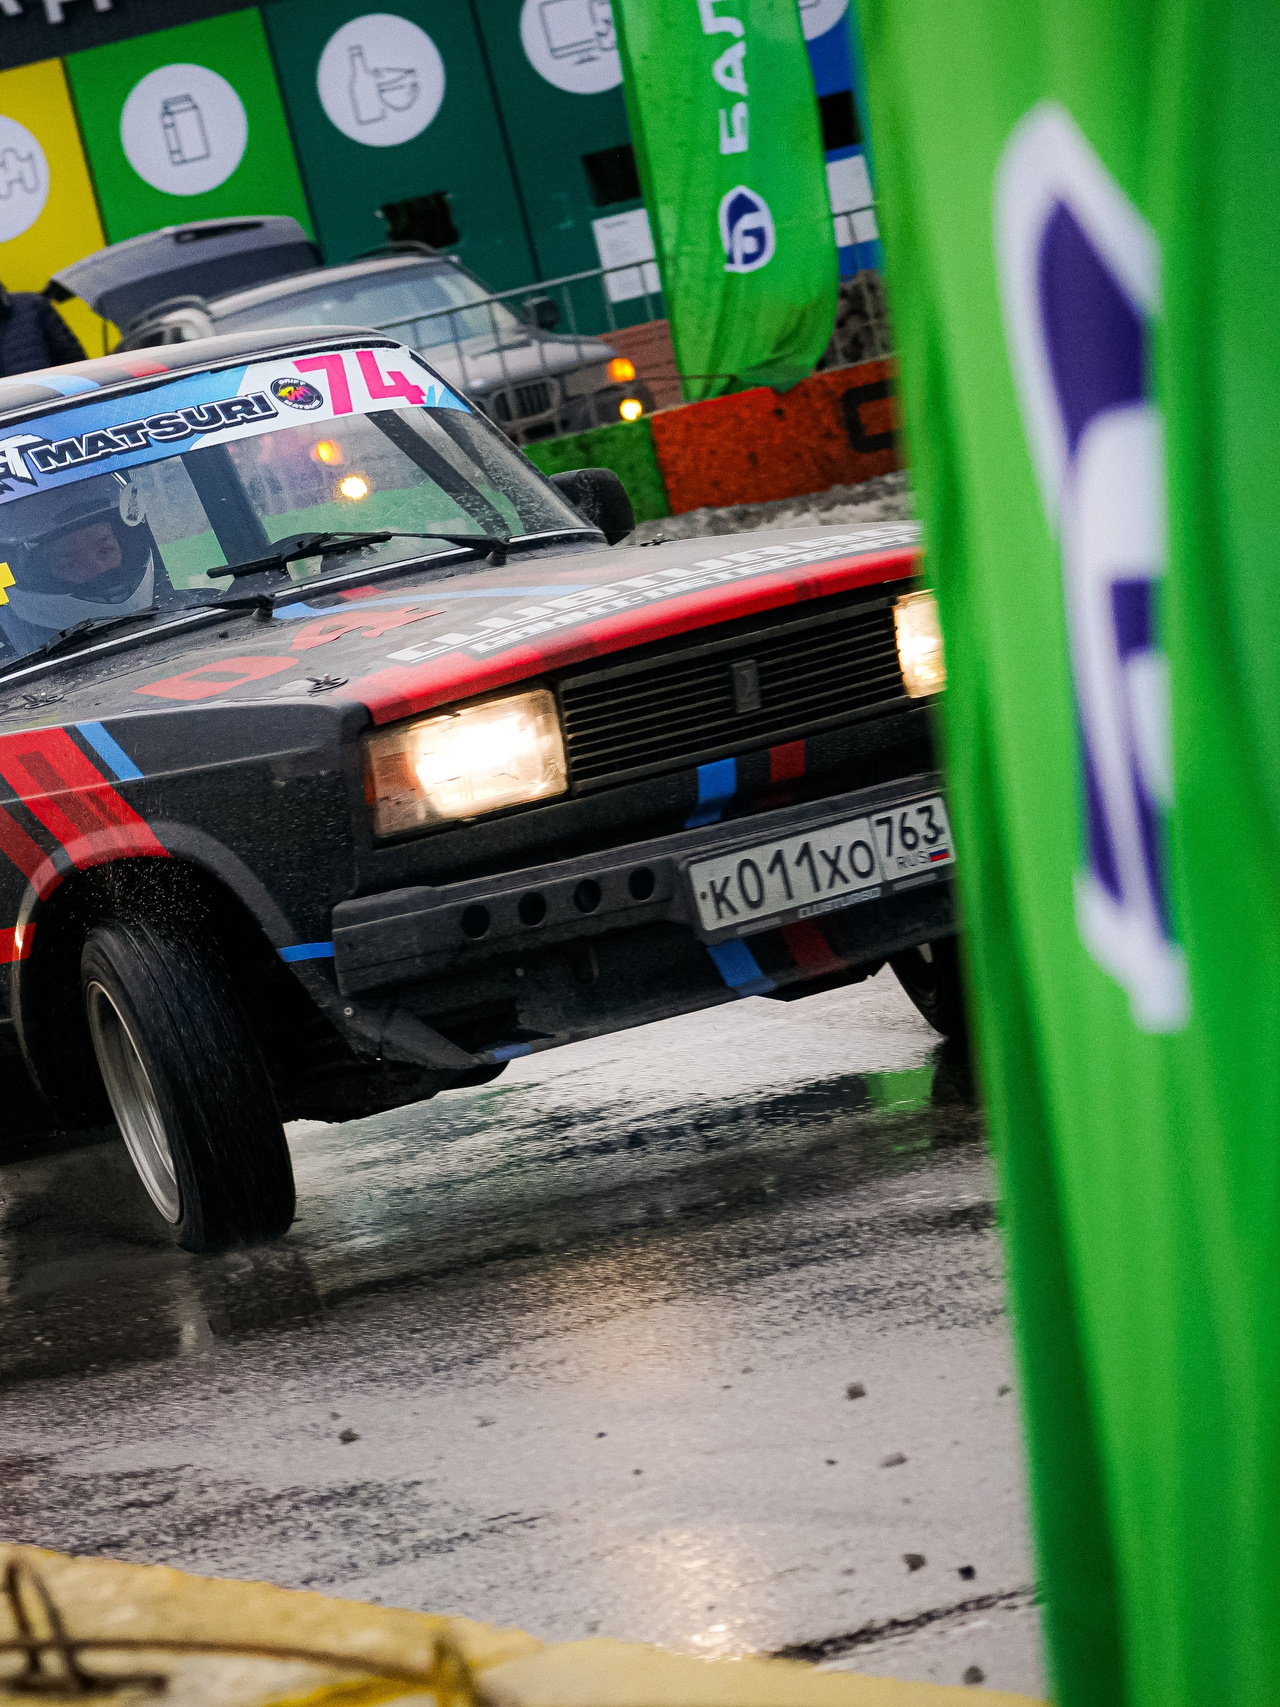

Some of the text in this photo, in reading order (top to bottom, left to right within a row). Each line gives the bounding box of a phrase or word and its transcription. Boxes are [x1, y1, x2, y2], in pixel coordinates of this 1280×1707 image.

[292, 350, 426, 415] 74
[25, 389, 279, 476] MATSURI
[875, 804, 945, 858] 763
[897, 851, 929, 870] RUS
